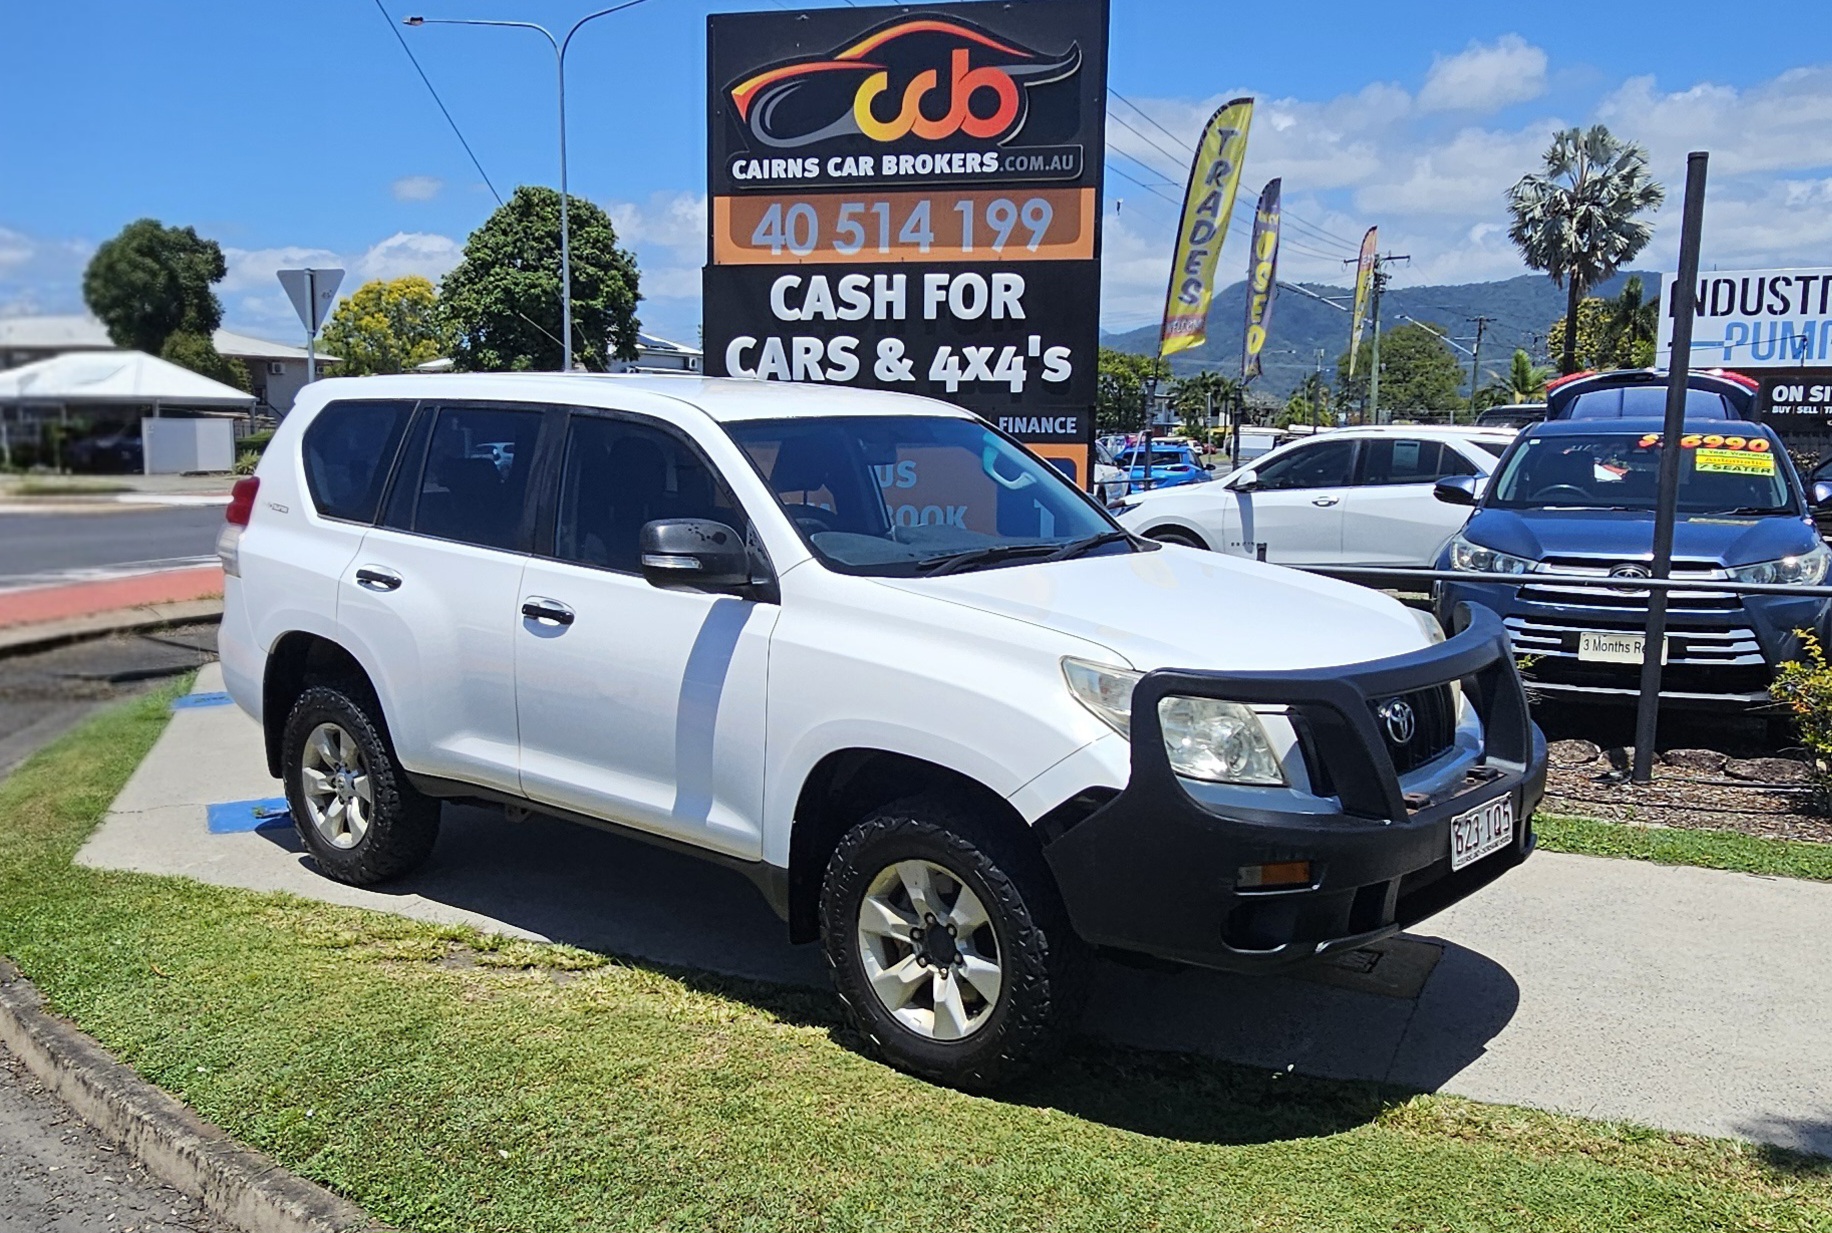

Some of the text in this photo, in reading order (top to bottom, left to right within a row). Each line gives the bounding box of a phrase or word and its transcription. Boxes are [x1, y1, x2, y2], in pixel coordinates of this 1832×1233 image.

[732, 157, 820, 180] CAIRNS
[827, 155, 874, 178] CAR
[1178, 128, 1238, 306] TRADES
[752, 197, 1054, 256] 40 514 199
[770, 272, 1026, 322] CASH FOR
[725, 335, 860, 382] CARS
[874, 337, 916, 382] &
[1772, 385, 1832, 402] ON SI
[1771, 405, 1792, 414] BUY
[1796, 405, 1819, 414] SELL
[999, 416, 1077, 434] FINANCE
[1705, 457, 1764, 467] Automatic
[1731, 451, 1771, 460] Warranty
[1712, 464, 1771, 474] SEATER
[1583, 638, 1590, 651] 3
[1593, 636, 1631, 654] Months
